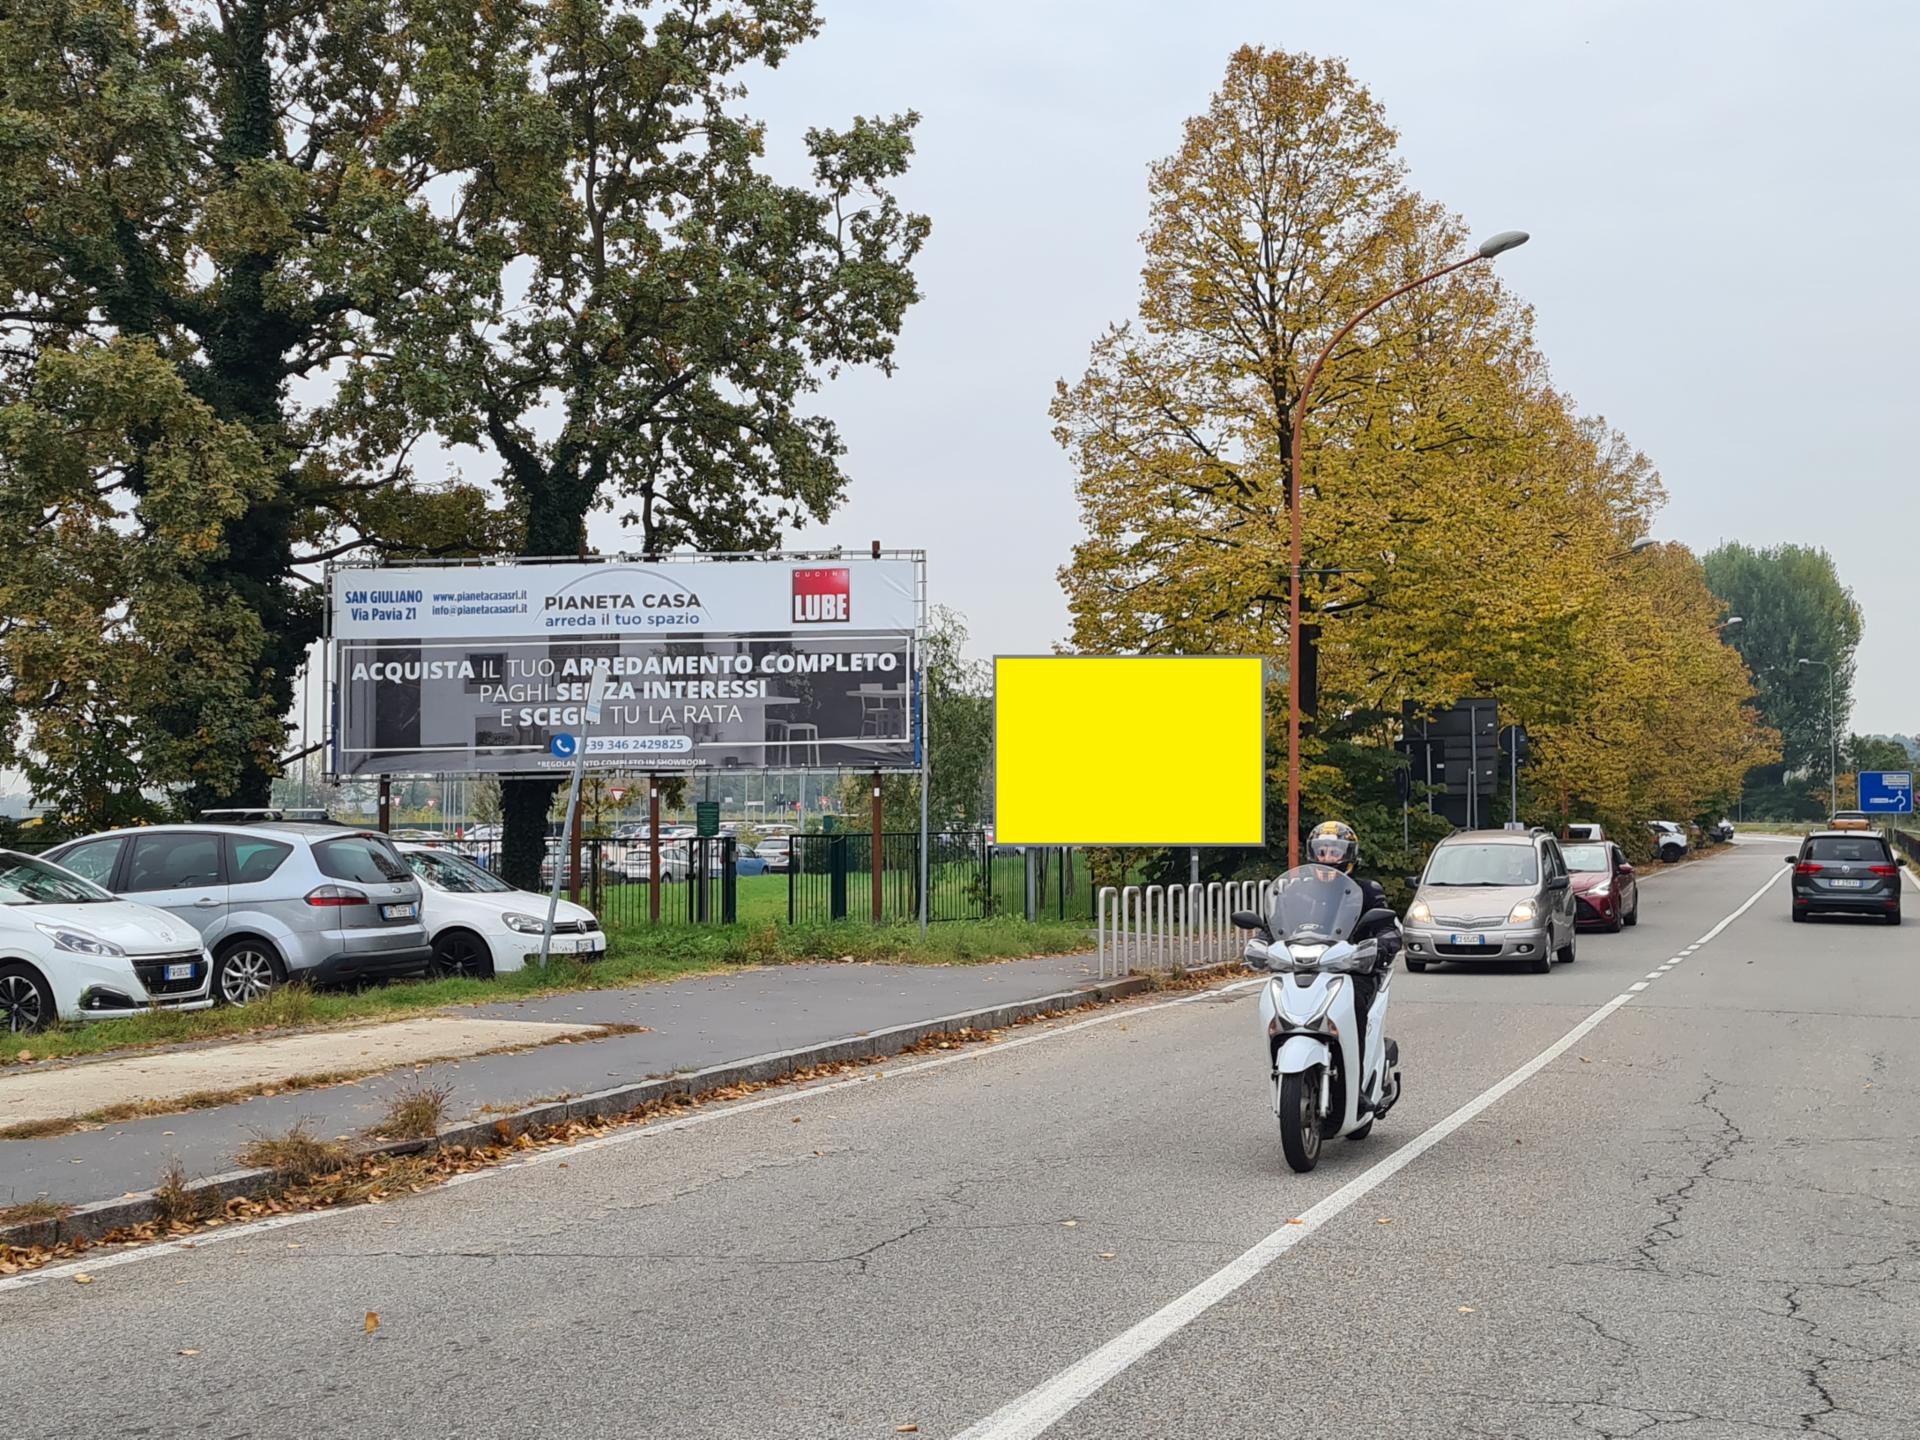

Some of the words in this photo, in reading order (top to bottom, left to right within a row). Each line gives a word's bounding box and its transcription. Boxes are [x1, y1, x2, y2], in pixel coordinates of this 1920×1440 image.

[345, 591, 367, 604] SAN
[370, 590, 423, 604] GIULIANO
[433, 590, 527, 602] www.pianetacasasrl.it
[545, 595, 635, 610] PIANETA
[642, 593, 701, 609] CASA
[351, 607, 369, 621] Via
[371, 607, 401, 621] Pavia
[405, 607, 416, 620] 21
[432, 603, 527, 616] info@pianetacasasrl.it
[795, 593, 847, 621] LUBE
[545, 614, 596, 627] arreda
[601, 613, 610, 626] il
[615, 614, 642, 626] tuo
[647, 612, 700, 627] spazio
[351, 660, 475, 684] ACQUISTA
[482, 661, 501, 678] IL
[507, 659, 555, 677] TUO
[562, 655, 753, 676] ARREDAMENTO
[760, 652, 898, 673] COMPLETO
[480, 683, 549, 703] PAGHI
[556, 681, 636, 701] SEZA
[643, 680, 766, 700] INTERESSI
[501, 708, 512, 727] E
[609, 705, 641, 724] TU
[648, 704, 676, 724] LA
[683, 705, 743, 723] RATA
[608, 739, 629, 750] 346
[633, 739, 684, 750] 2429825
[657, 758, 706, 768] SHOWROOM
